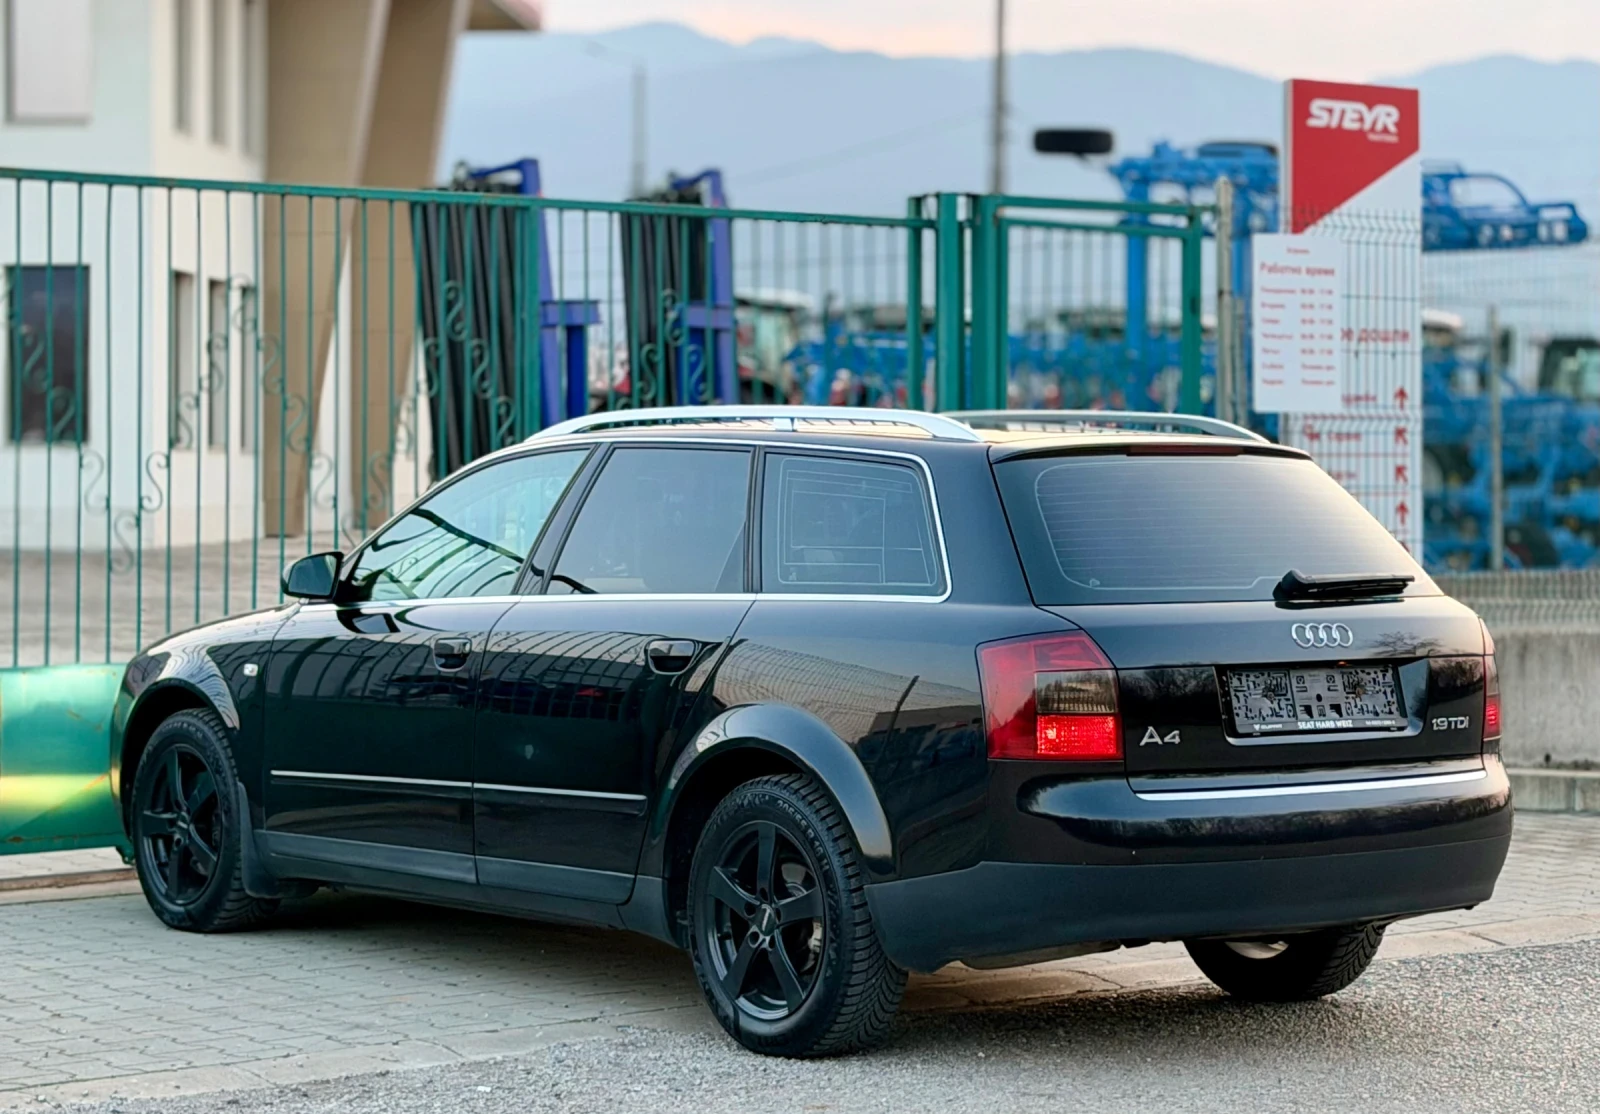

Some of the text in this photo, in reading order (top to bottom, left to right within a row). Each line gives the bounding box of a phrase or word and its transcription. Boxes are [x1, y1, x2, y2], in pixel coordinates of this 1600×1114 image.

[1306, 97, 1400, 133] STEYR
[1297, 720, 1315, 730] SEAT
[1139, 726, 1181, 747] A4
